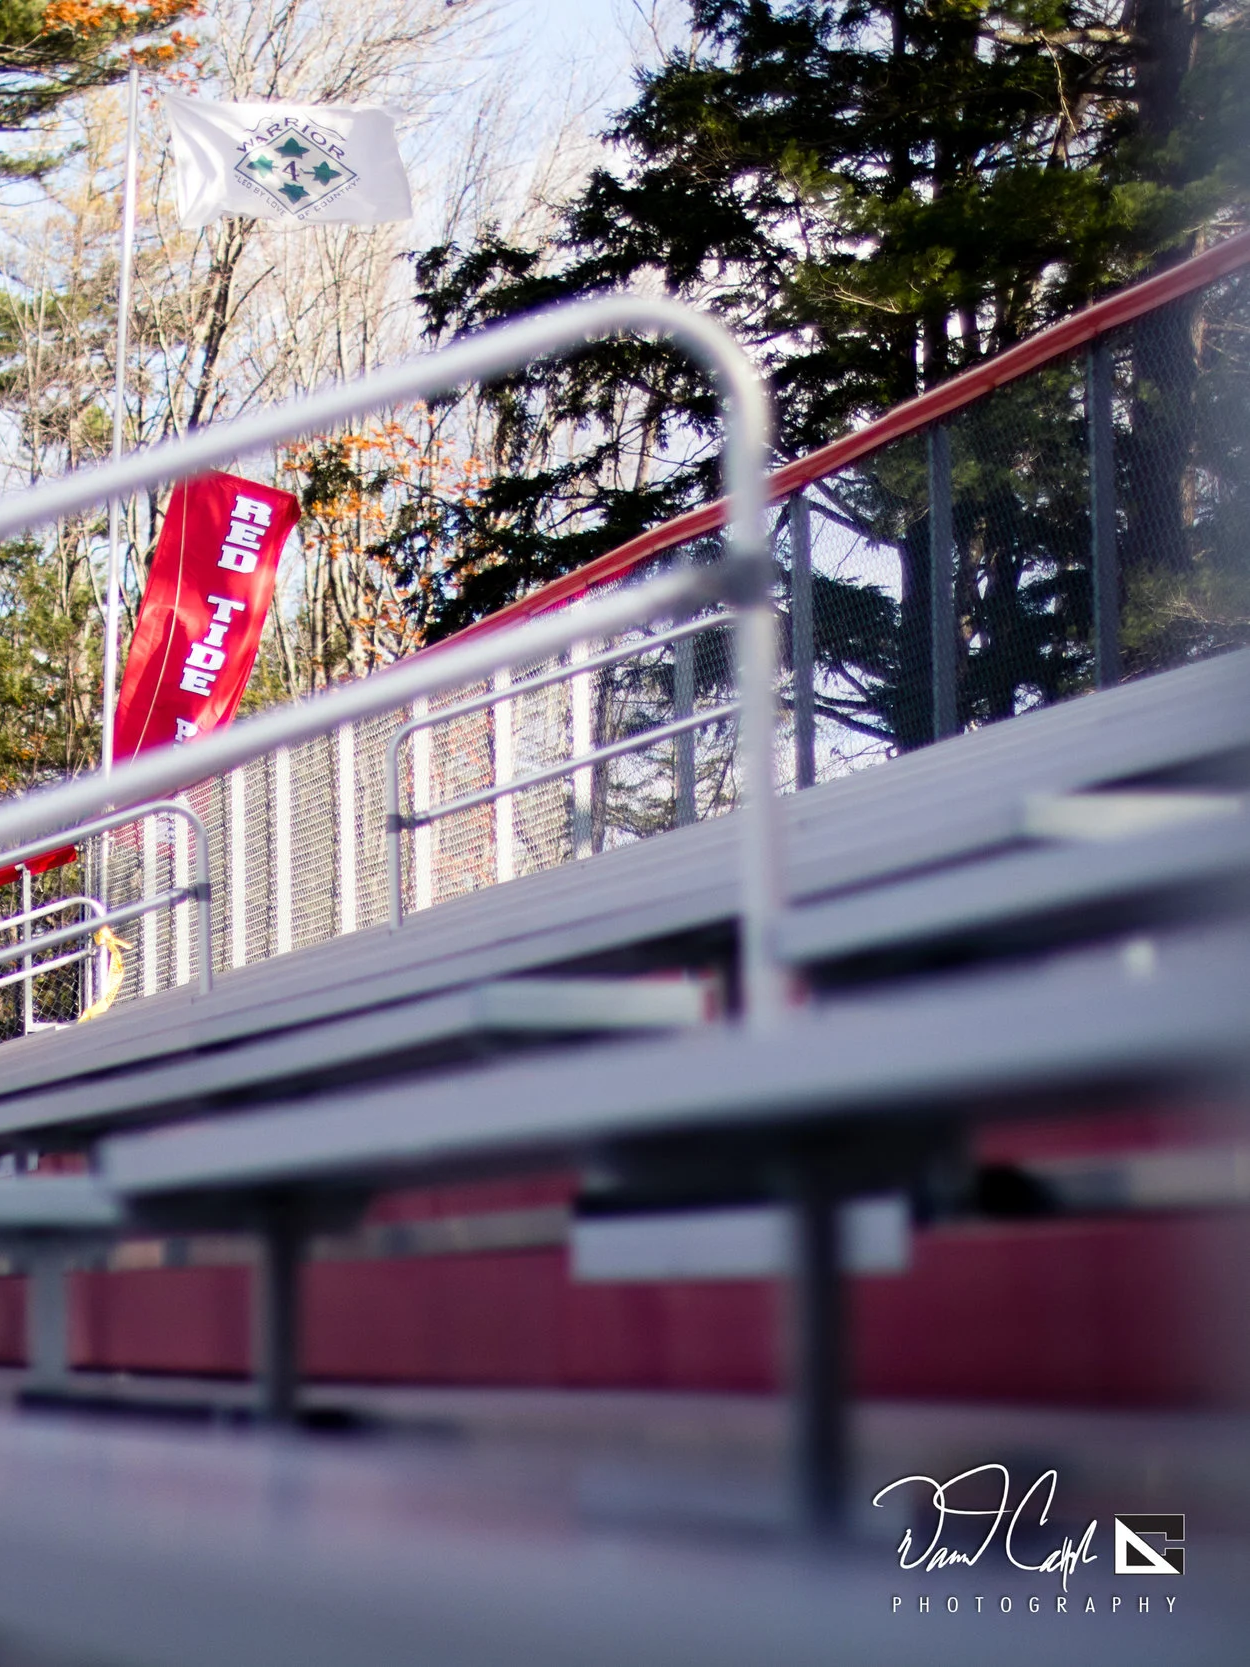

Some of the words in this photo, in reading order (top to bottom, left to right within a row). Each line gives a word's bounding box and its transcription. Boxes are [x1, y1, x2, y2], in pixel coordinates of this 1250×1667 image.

[236, 117, 345, 160] WARRIOR
[282, 160, 300, 182] 4
[253, 187, 266, 198] BY
[266, 198, 287, 217] LOVE
[297, 211, 310, 221] OF
[217, 495, 272, 574] RED
[179, 595, 246, 697] TIDE
